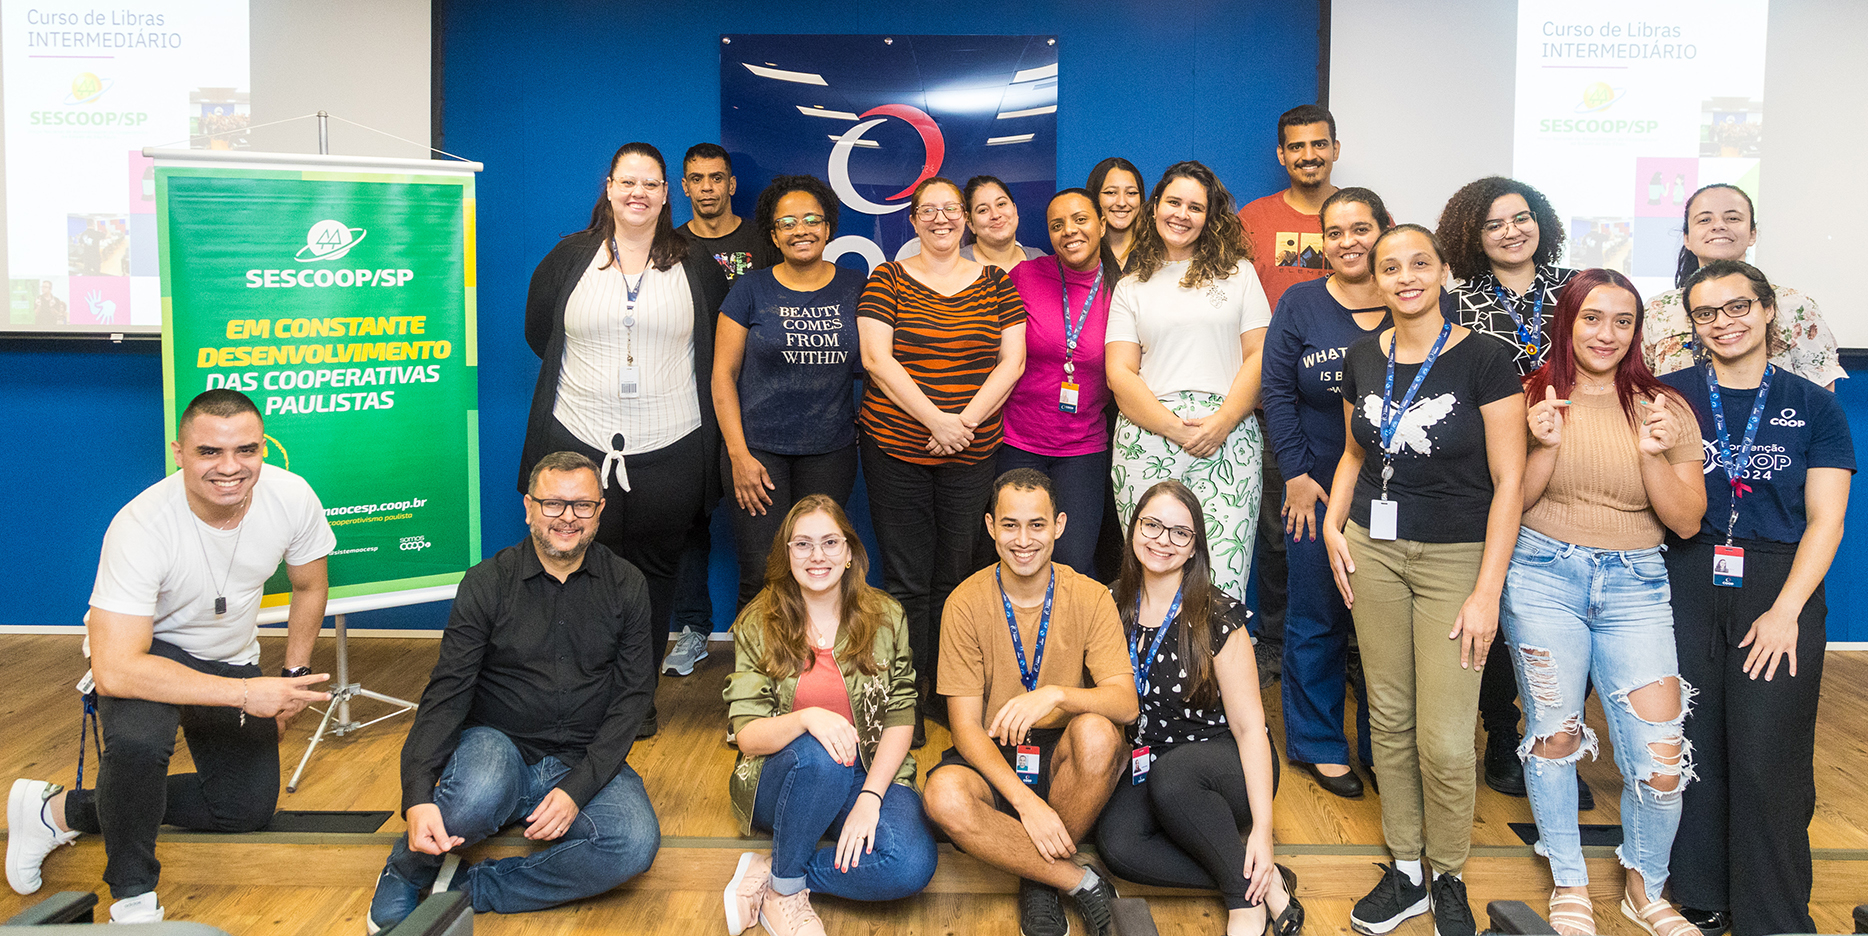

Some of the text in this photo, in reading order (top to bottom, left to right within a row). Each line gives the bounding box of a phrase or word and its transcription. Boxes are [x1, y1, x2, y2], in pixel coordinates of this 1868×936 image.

[27, 9, 165, 26] Curso de Libras
[28, 28, 182, 48] INTERMEDIÁRIO
[1542, 21, 1681, 38] Curso de Libras
[1542, 40, 1697, 60] INTERMEDIÁRIO
[30, 111, 148, 126] SESCOOP/SP
[1540, 119, 1659, 133] SESCOOP/SP
[245, 269, 414, 288] SESCOOP/SP
[779, 304, 841, 318] BEAUTY
[226, 315, 427, 339] EM CONSTANTE
[783, 318, 843, 331] COMES
[785, 332, 840, 348] FROM
[197, 340, 452, 368] DESENVOLVIMENTO
[781, 350, 849, 365] WITHIN
[1303, 347, 1348, 368] WHAT
[206, 365, 441, 392] DAS COOPERATIVAS
[1320, 371, 1332, 382] IS
[265, 391, 395, 415] PAULISTAS
[1769, 417, 1806, 428] COOP
[1711, 453, 1792, 471] COP
[323, 498, 427, 516] maocesp.coop.br
[384, 513, 413, 522] paulista
[399, 535, 425, 543] somos
